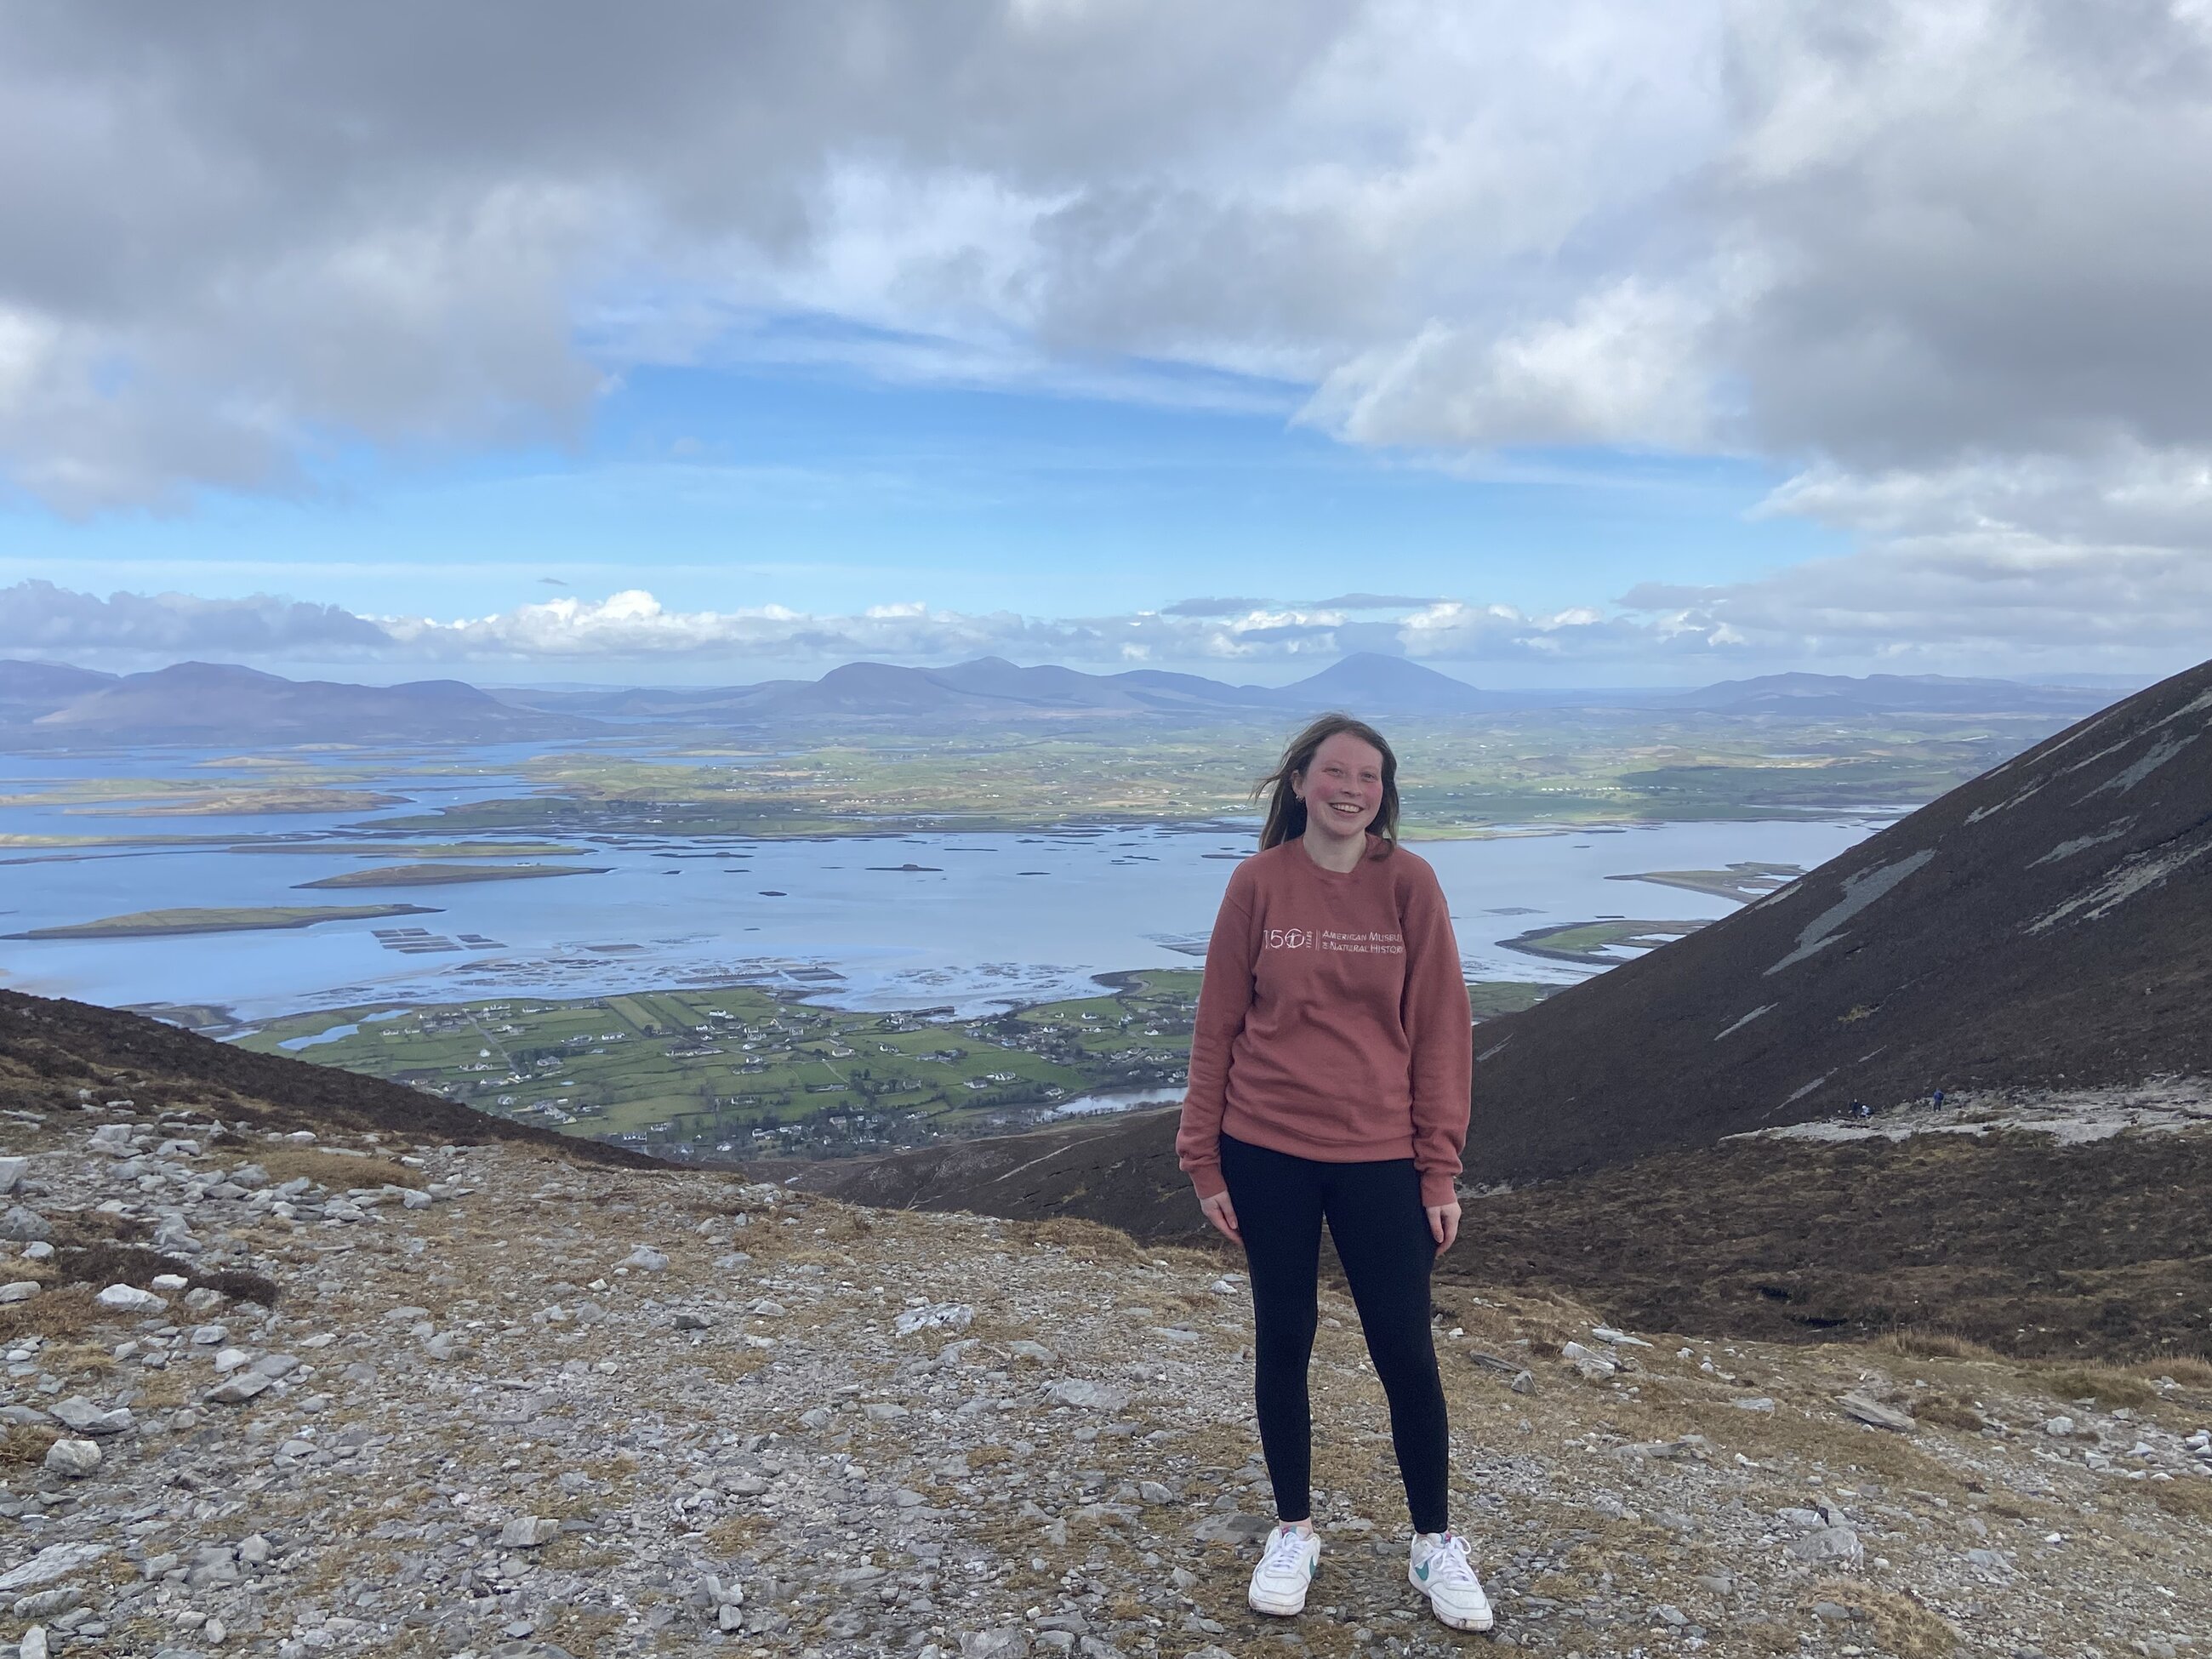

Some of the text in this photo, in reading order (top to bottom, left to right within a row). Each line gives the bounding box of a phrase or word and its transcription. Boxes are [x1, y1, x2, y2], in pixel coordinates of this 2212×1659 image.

[1263, 928, 1304, 949] 150
[1369, 932, 1402, 942] MUSEU
[1330, 941, 1369, 952] NATURAL
